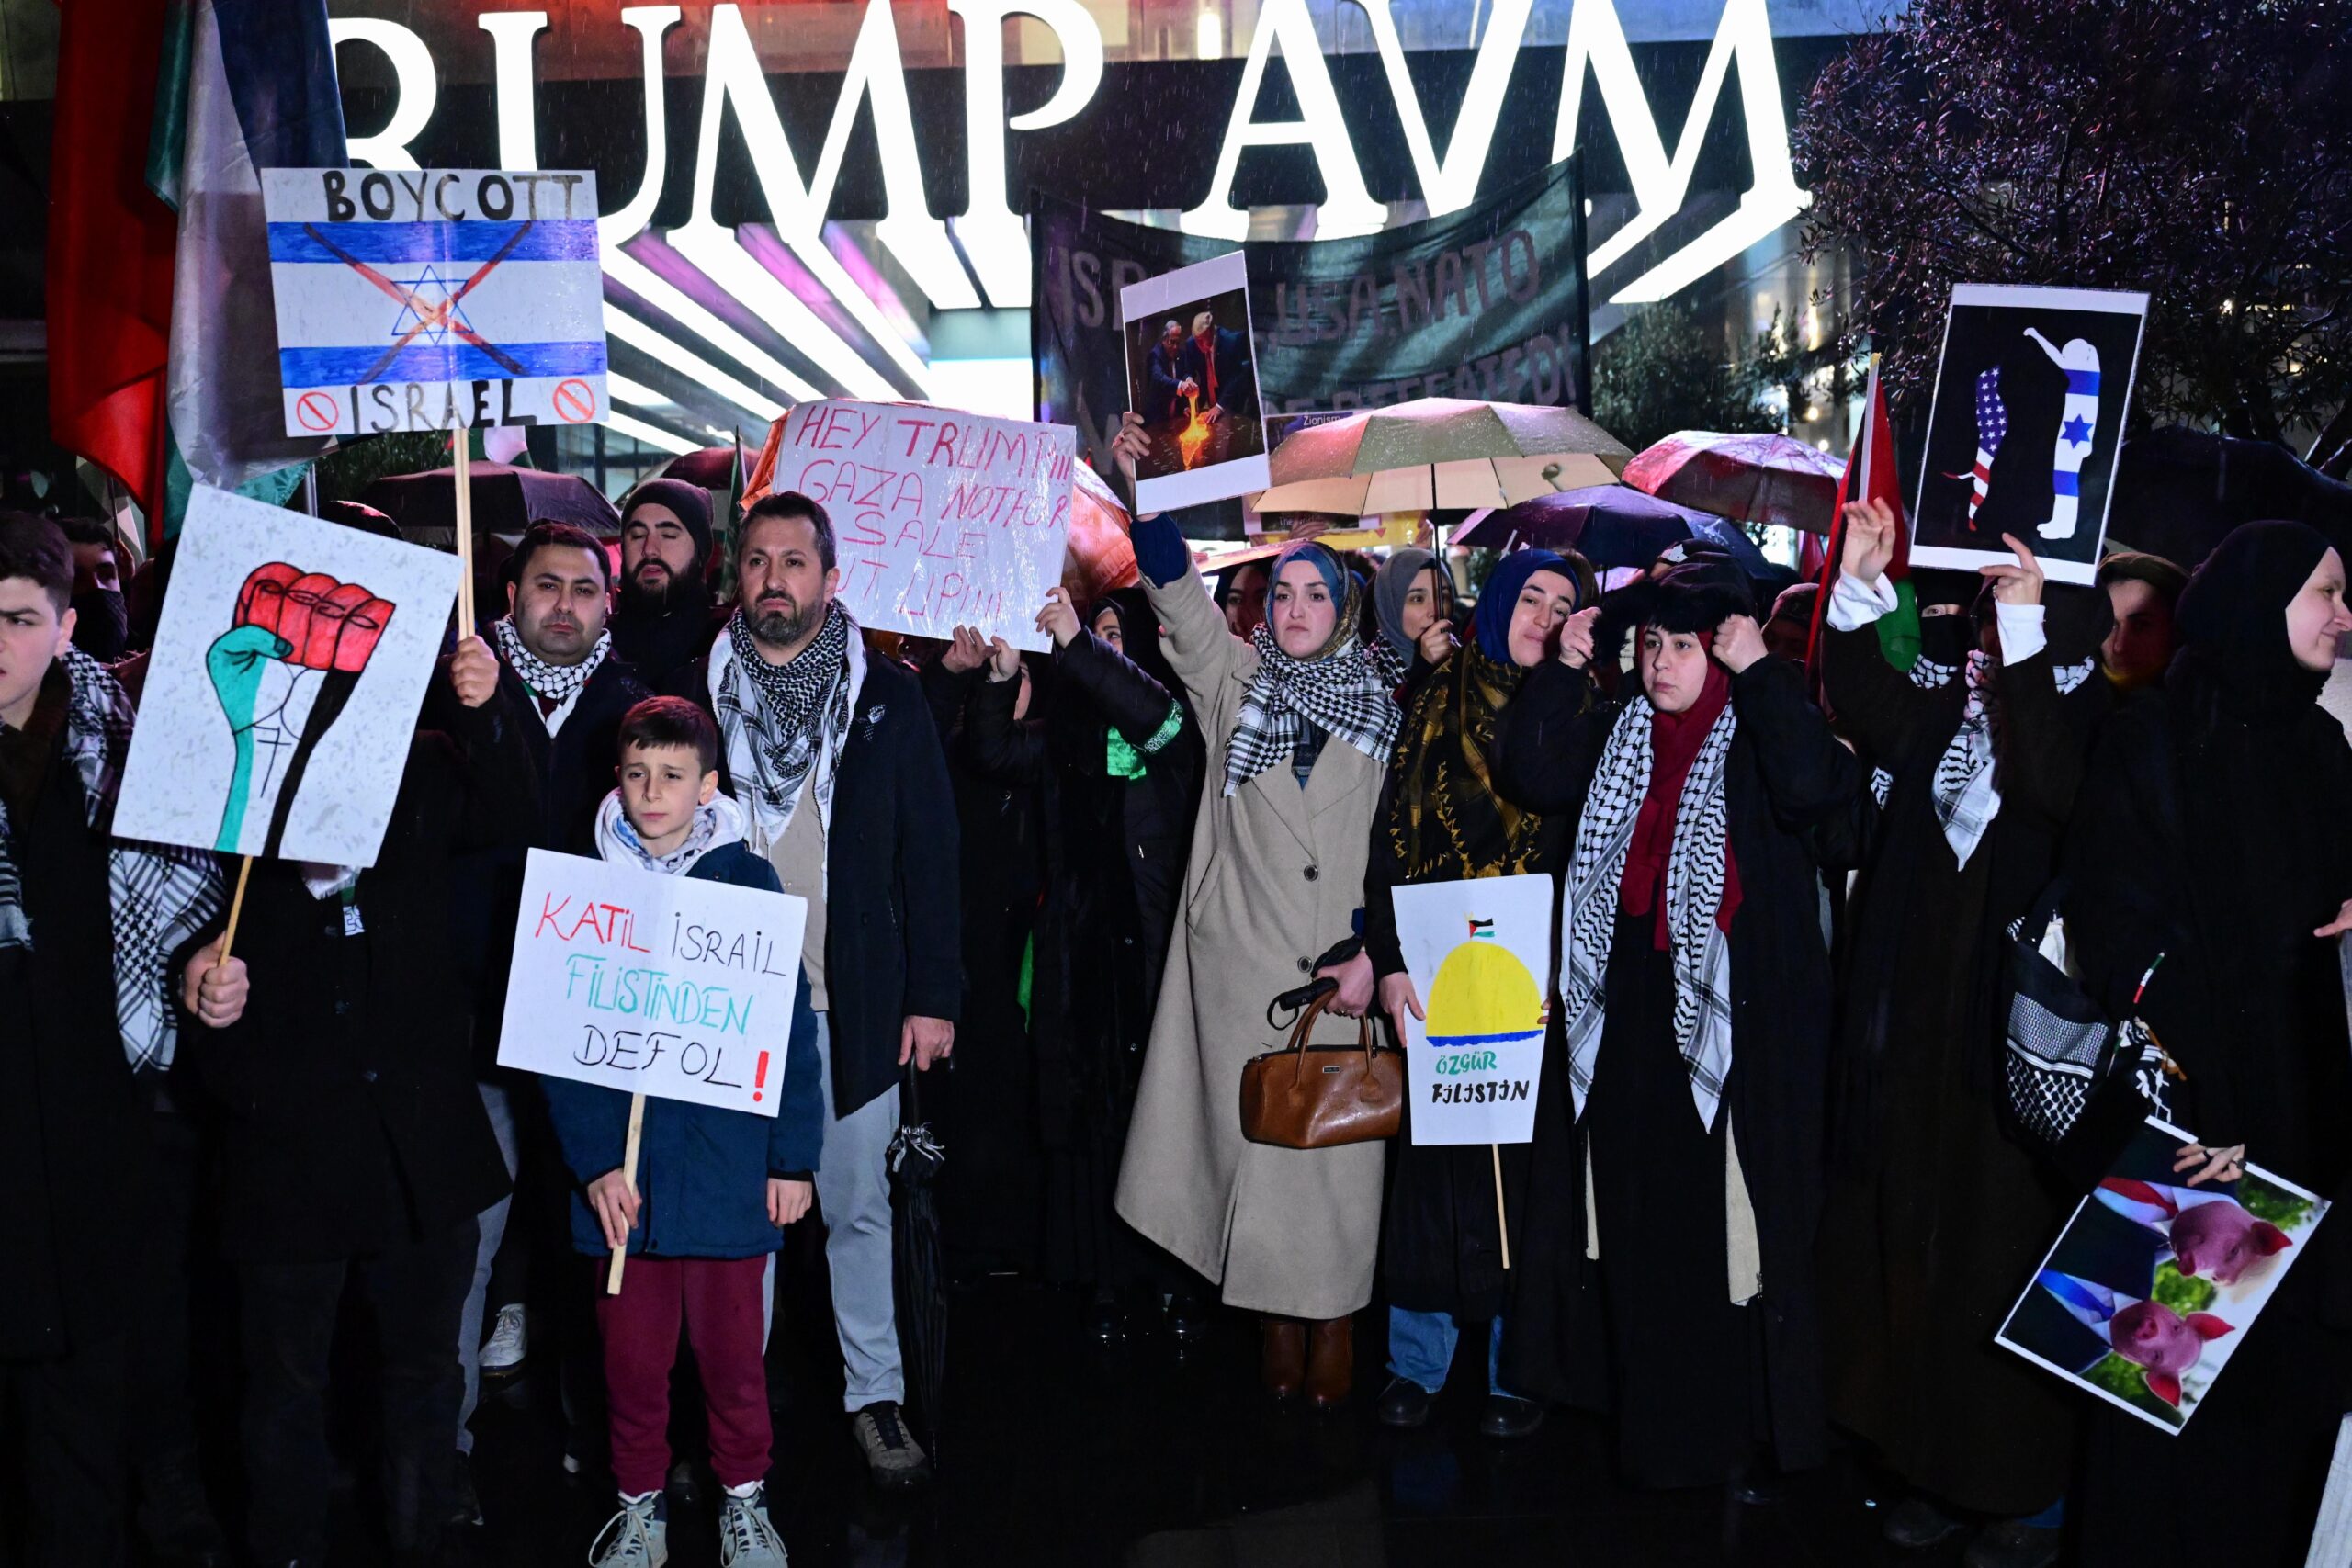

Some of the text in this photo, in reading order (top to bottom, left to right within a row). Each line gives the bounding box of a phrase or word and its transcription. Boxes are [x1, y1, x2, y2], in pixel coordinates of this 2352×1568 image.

[326, 0, 1814, 246] RUMP AVM
[322, 169, 582, 222] BOYCOTT
[350, 378, 537, 435] ISRAEL
[796, 405, 881, 449] HEY
[1303, 413, 1340, 427] Zionism
[798, 459, 922, 516] GAZA
[842, 511, 987, 559] SALE
[671, 912, 786, 976] İSRAİL
[1435, 1050, 1498, 1076] ÖZGÜR
